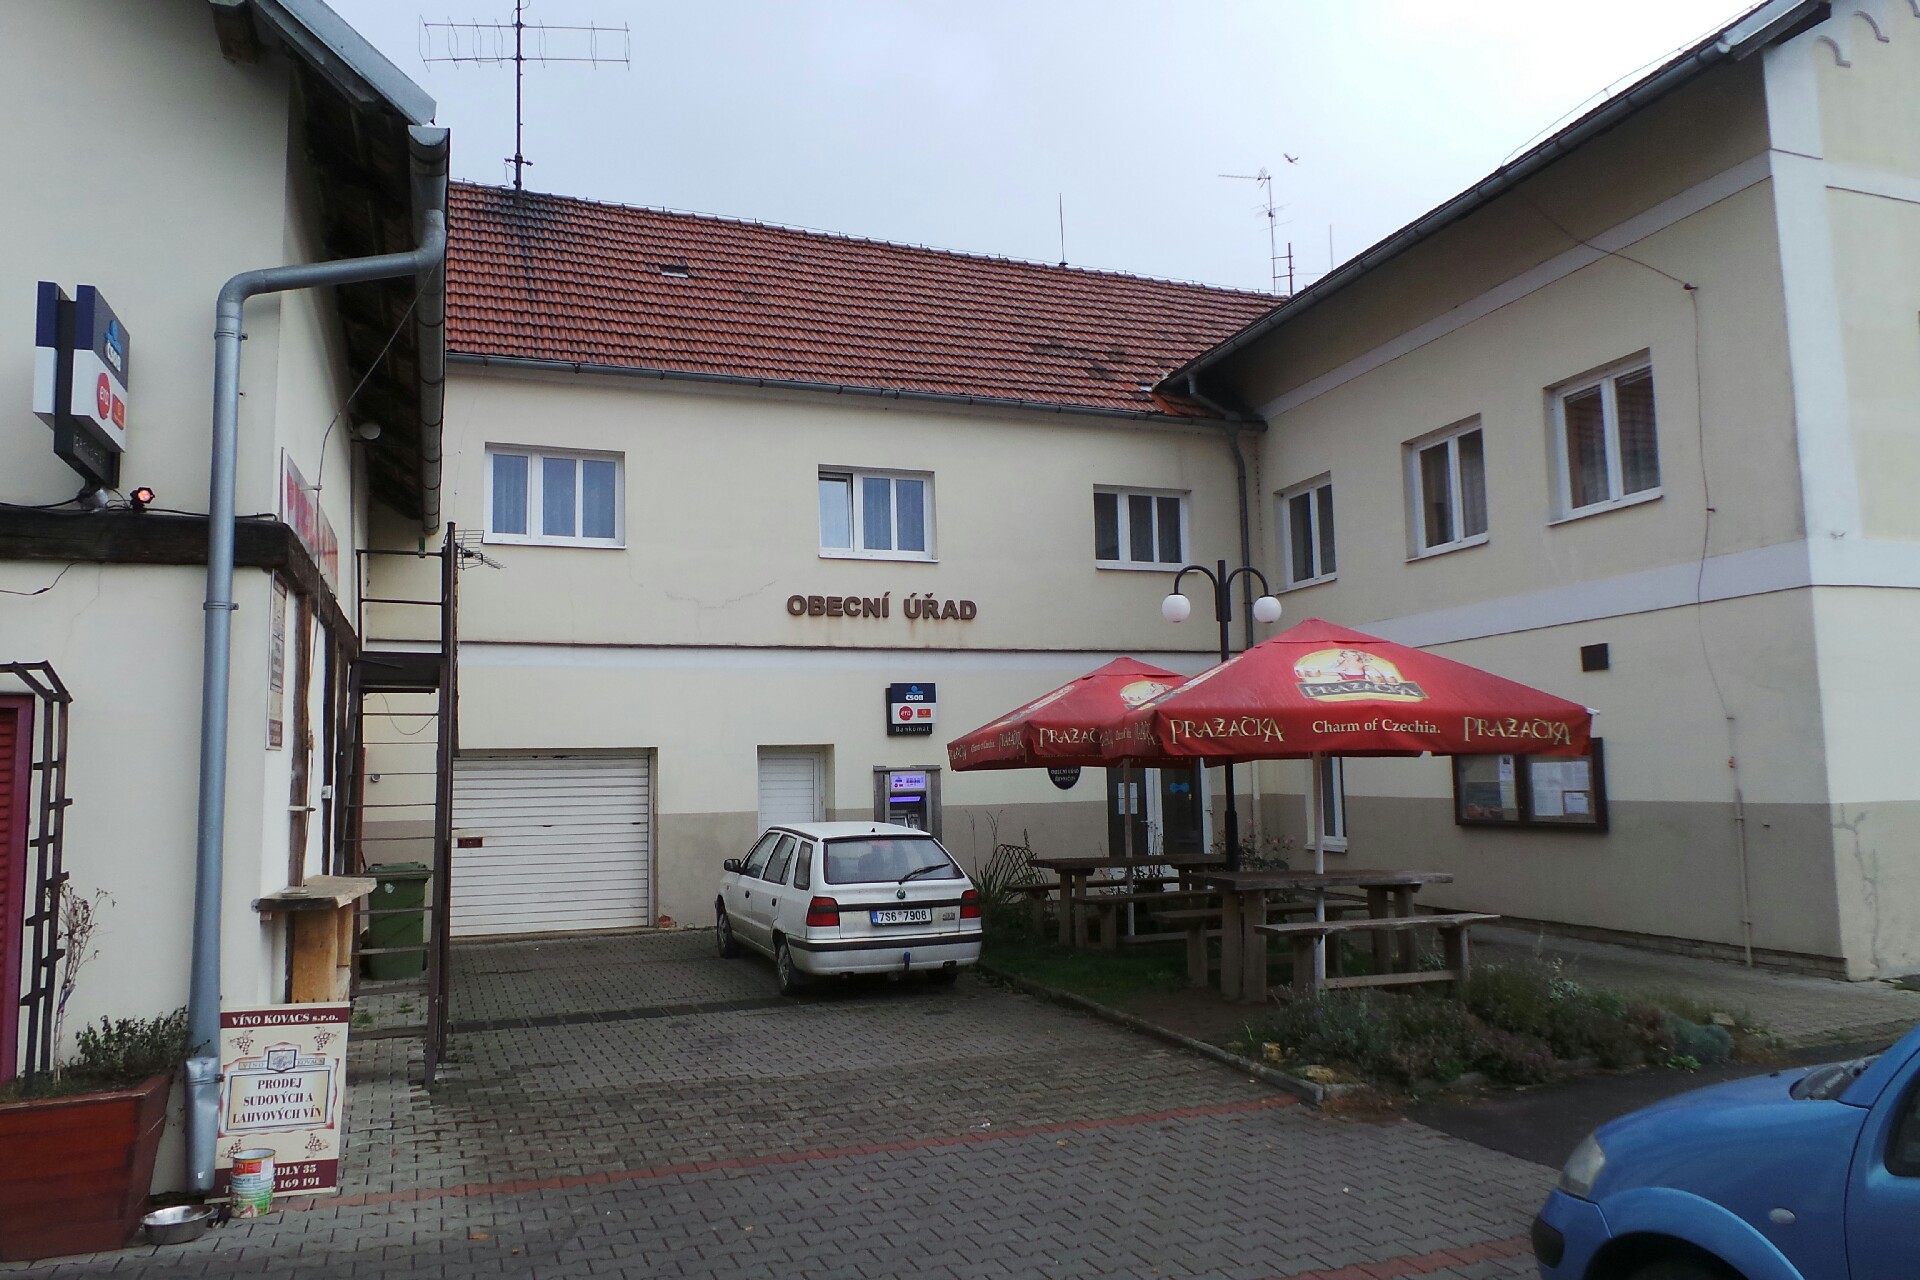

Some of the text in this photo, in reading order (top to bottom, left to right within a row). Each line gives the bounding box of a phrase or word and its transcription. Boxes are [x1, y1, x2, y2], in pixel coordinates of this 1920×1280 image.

[787, 591, 978, 620] OBECNÍ ÚŘAD
[895, 725, 931, 733] Bankomat
[1169, 716, 1285, 745] PRAŽAČKA
[1312, 718, 1441, 734] Charm of Czechia.
[1463, 716, 1572, 745] PRAŽAČKA
[879, 912, 897, 922] 7S6
[904, 910, 927, 921] 7908
[232, 1013, 339, 1026] VÍNO KOVACS s.r.o.
[257, 1077, 302, 1090] PRODEJ
[243, 1090, 314, 1107] SUDOVÝCH A
[232, 1104, 322, 1124] LAHVOVÝCH VÍN
[302, 1163, 317, 1174] 35
[280, 1179, 299, 1189] 169
[302, 1177, 321, 1187] 191
